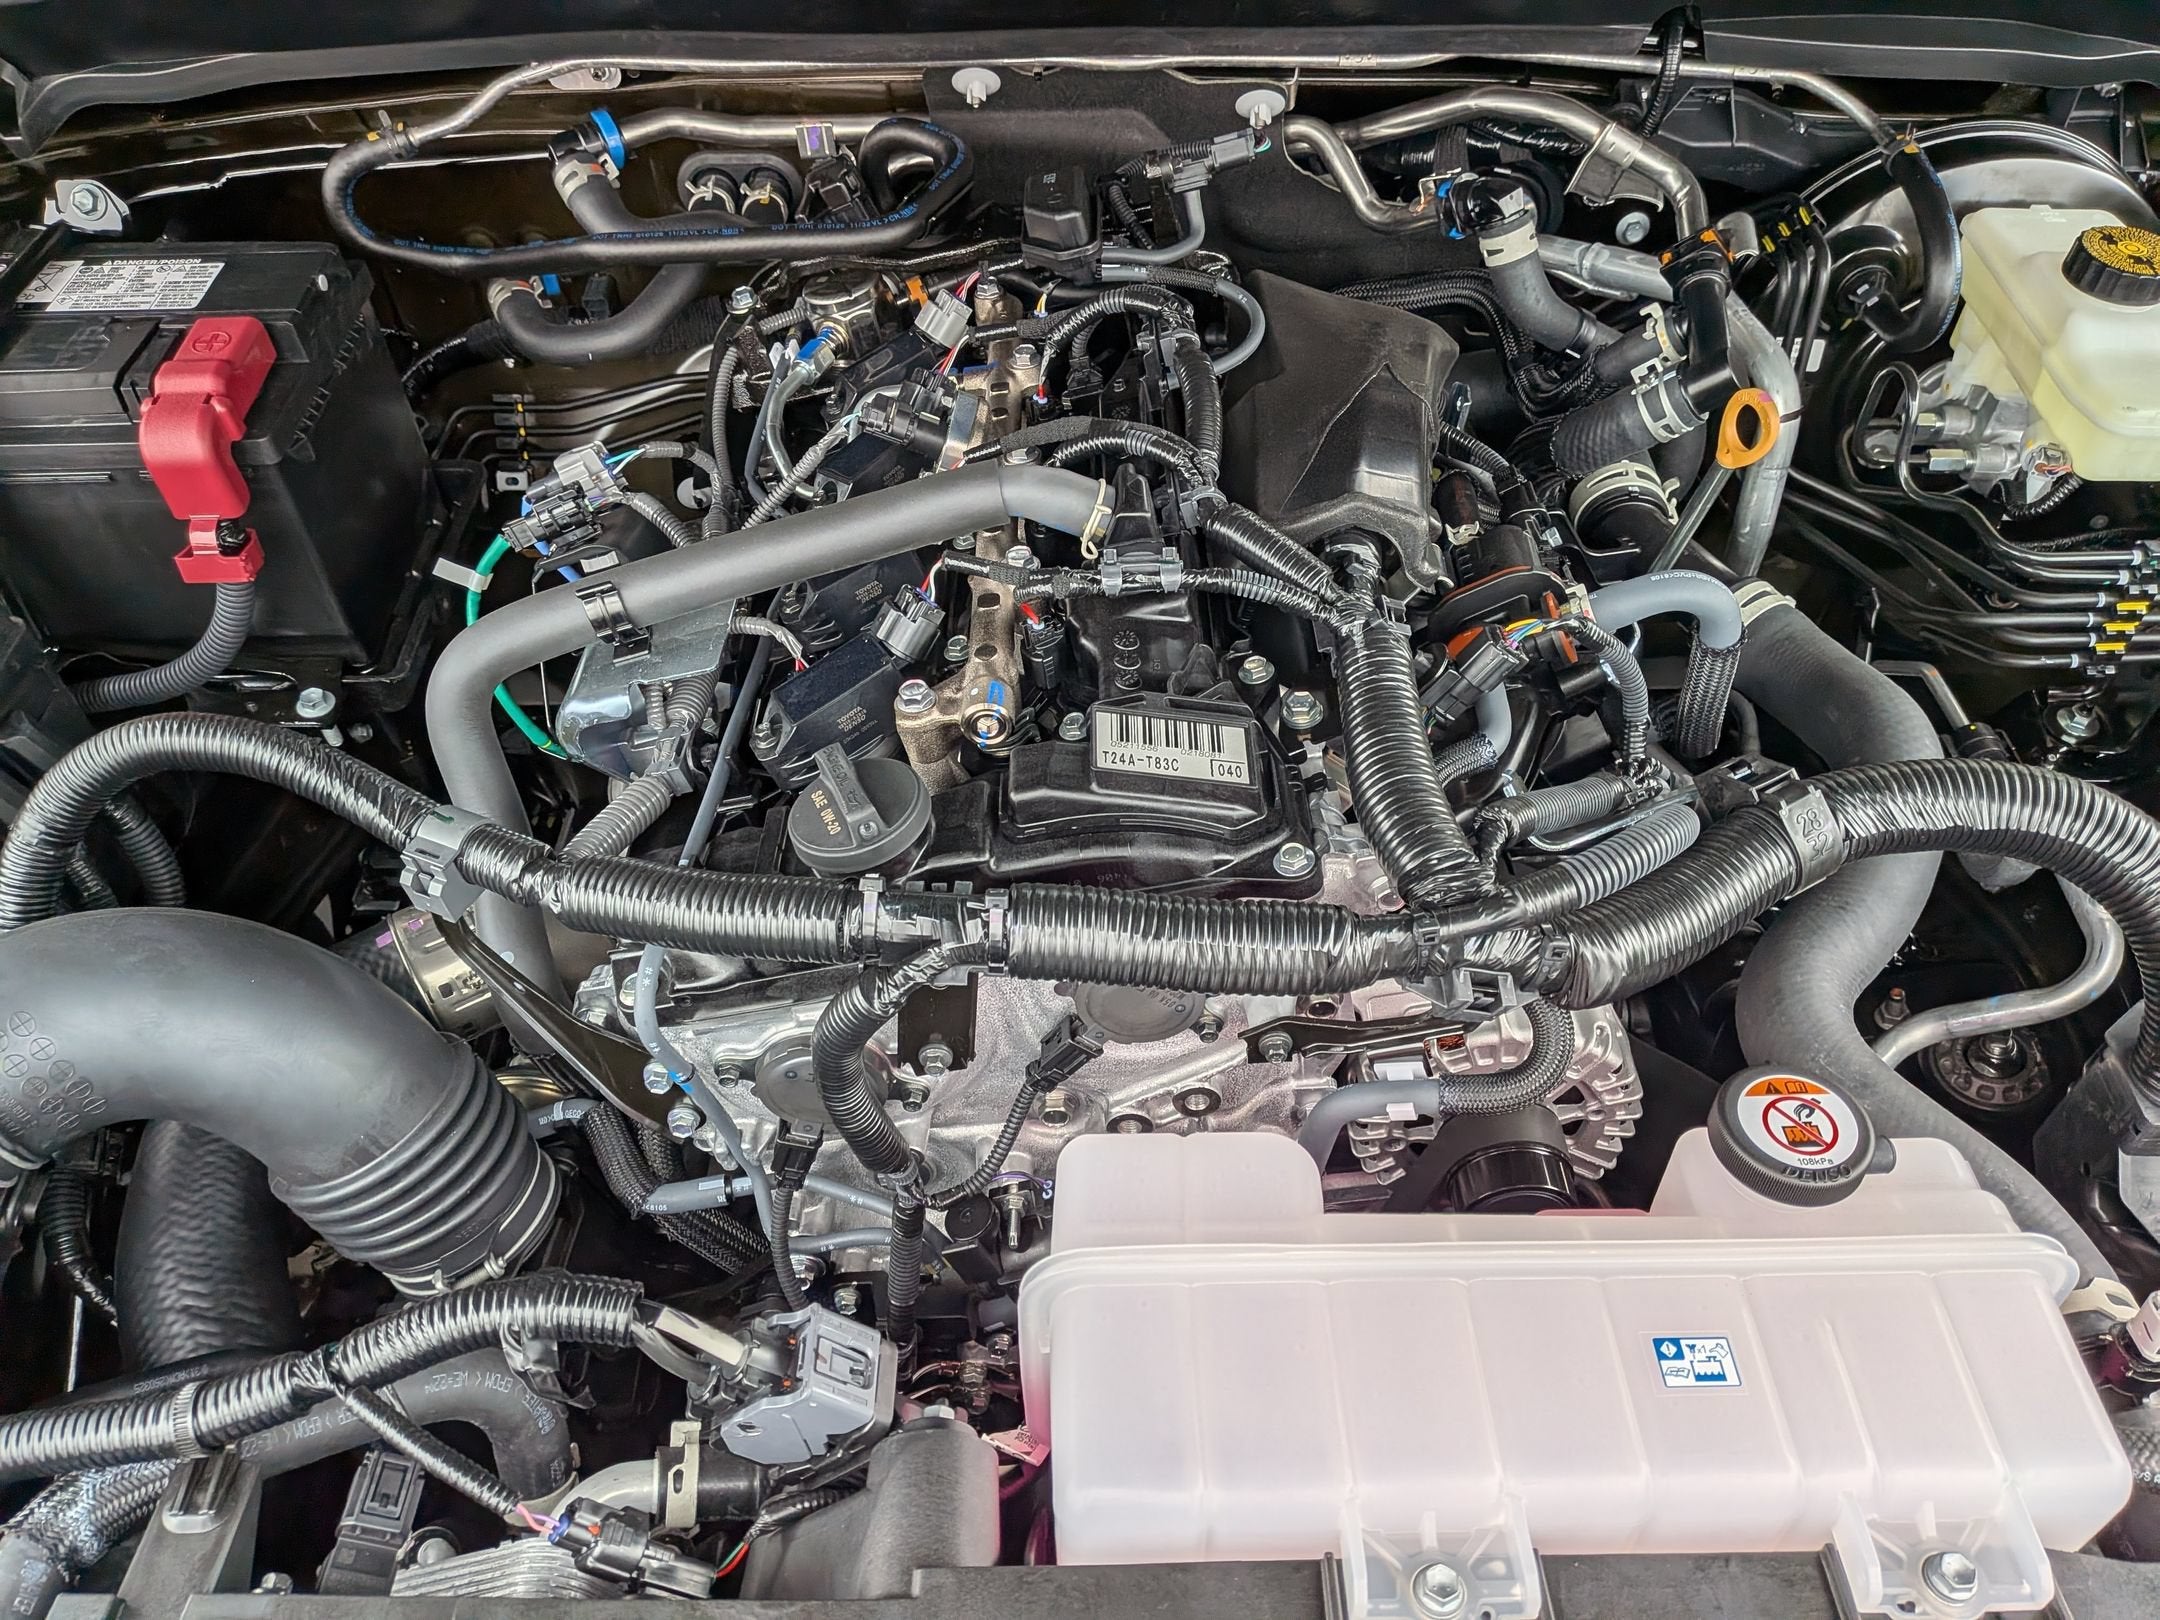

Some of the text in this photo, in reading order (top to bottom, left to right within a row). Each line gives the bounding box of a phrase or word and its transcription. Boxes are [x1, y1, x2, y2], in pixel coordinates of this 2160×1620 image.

[854, 580, 879, 595] TOYOTA
[837, 706, 863, 724] TOYOTA
[844, 714, 866, 732] DENSO
[1102, 750, 1180, 772] T24A-T83C
[1218, 763, 1243, 778] 040
[811, 790, 842, 835] SAE 0W-20
[1796, 807, 1822, 838] 28
[1807, 831, 1834, 862] 32
[1798, 1157, 1834, 1166] 108kPa
[1782, 1163, 1853, 1184] DENSO
